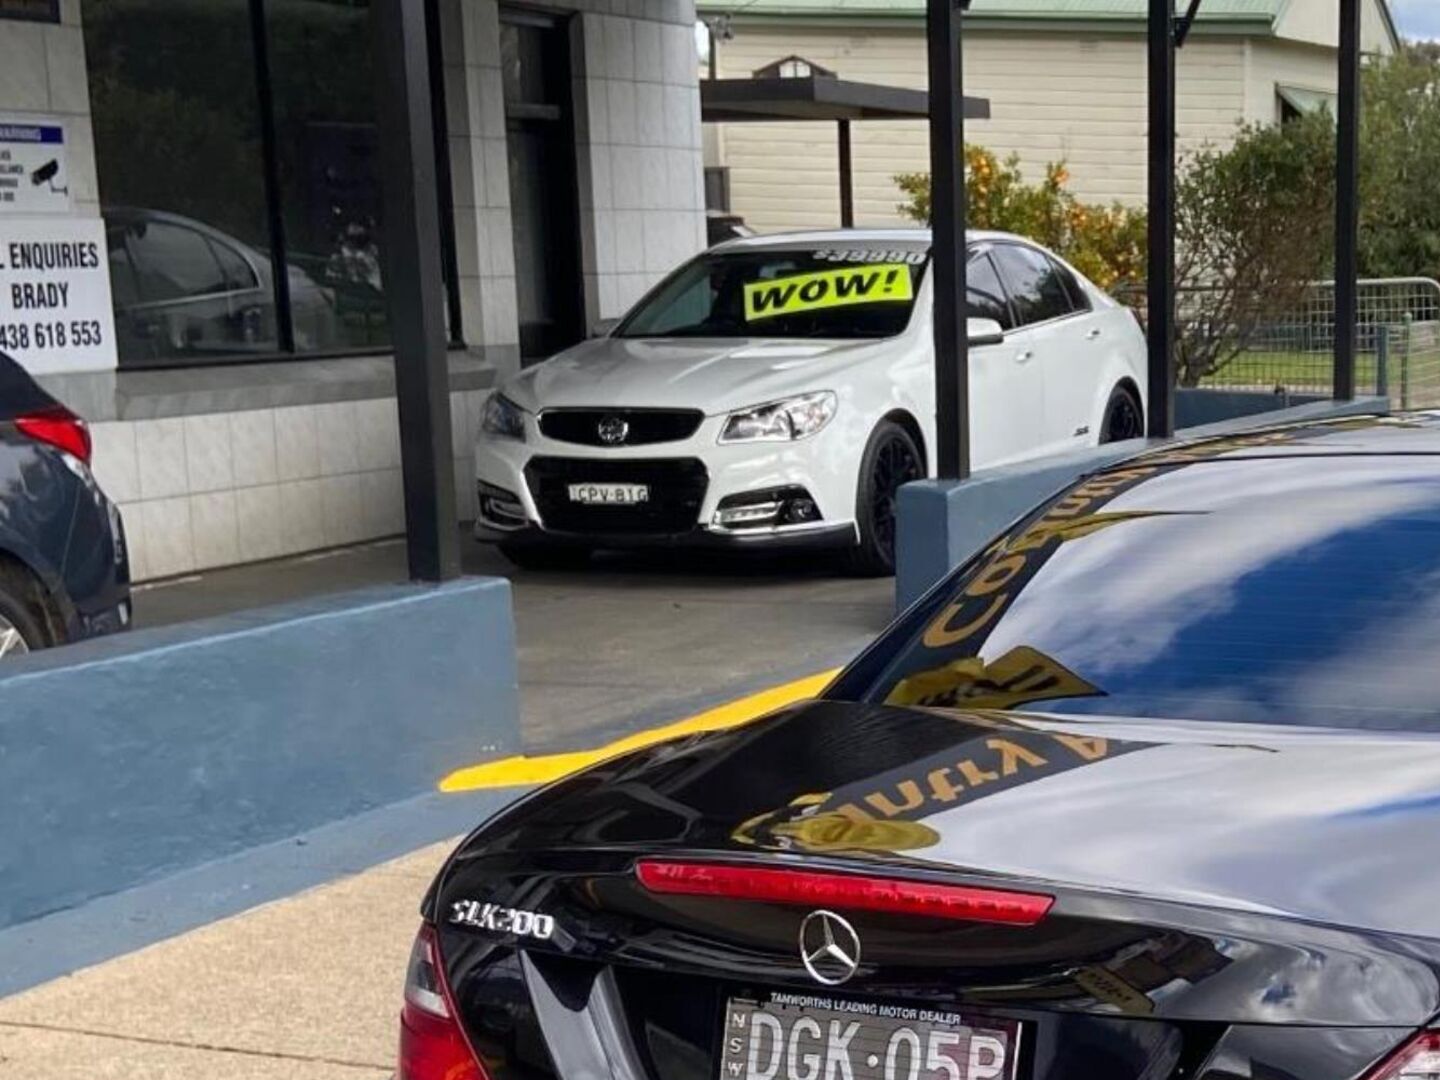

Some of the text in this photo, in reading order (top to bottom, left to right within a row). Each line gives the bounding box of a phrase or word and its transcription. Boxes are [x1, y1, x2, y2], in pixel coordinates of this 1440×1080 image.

[9, 241, 99, 271] ENQUIRIES
[11, 281, 69, 309] BRADY
[751, 269, 899, 313] WOW!
[34, 321, 66, 348] 618
[70, 319, 102, 346] 553
[449, 899, 555, 939] SLK200
[770, 992, 962, 1026] TAMWORTHS LEADING MOTOR DEALER
